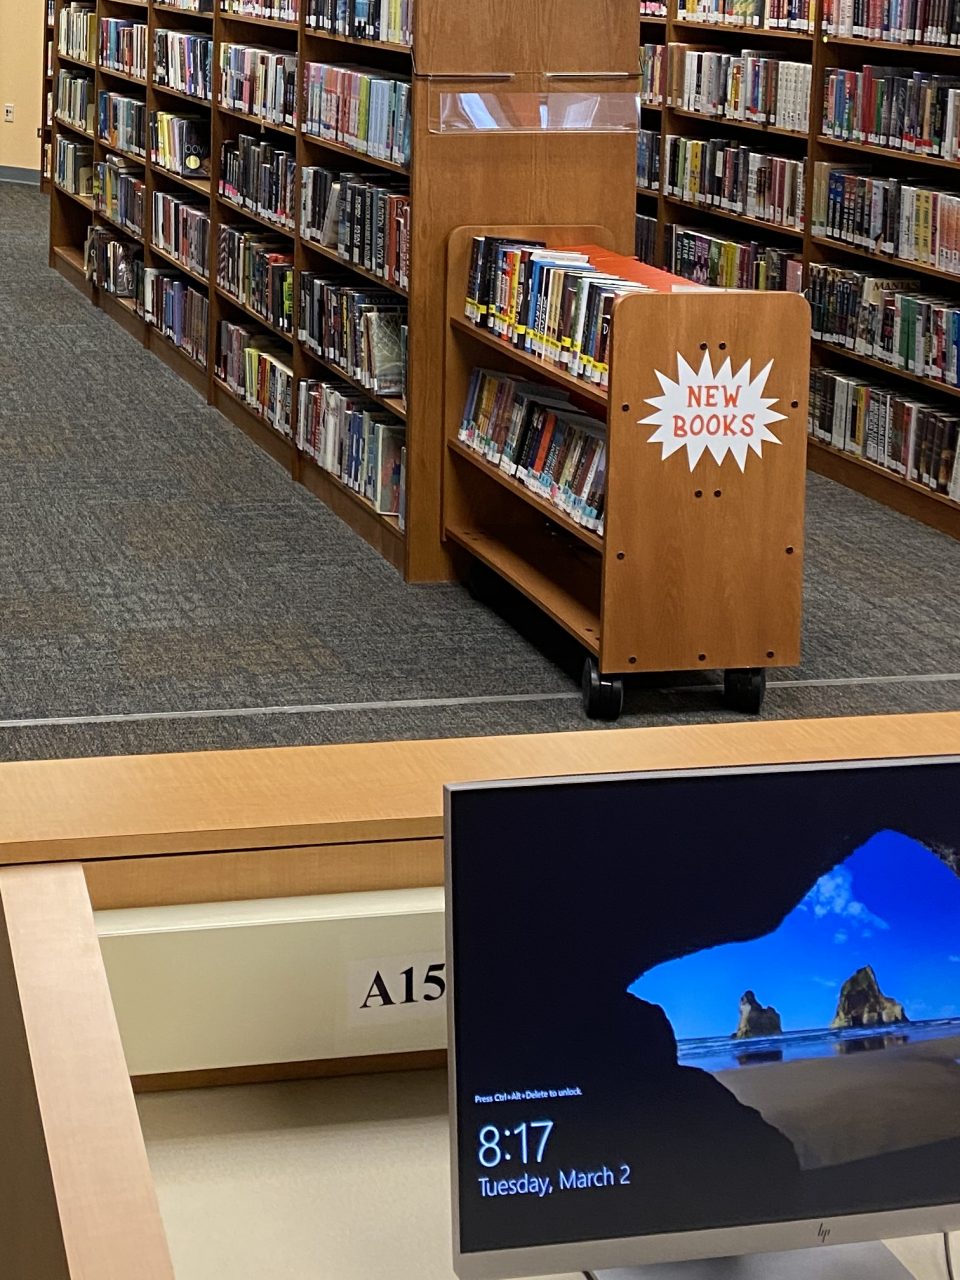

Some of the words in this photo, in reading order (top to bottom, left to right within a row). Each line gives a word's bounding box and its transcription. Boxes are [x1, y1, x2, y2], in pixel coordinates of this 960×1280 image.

[687, 385, 742, 408] NEW
[672, 413, 756, 438] BOOKS
[359, 963, 446, 1009] A15
[475, 1095, 493, 1103] Press
[478, 1121, 554, 1168] 8:17
[478, 1173, 553, 1197] Tuesday,
[559, 1167, 614, 1190] March
[620, 1165, 631, 1184] 2
[817, 1222, 831, 1243] hp
